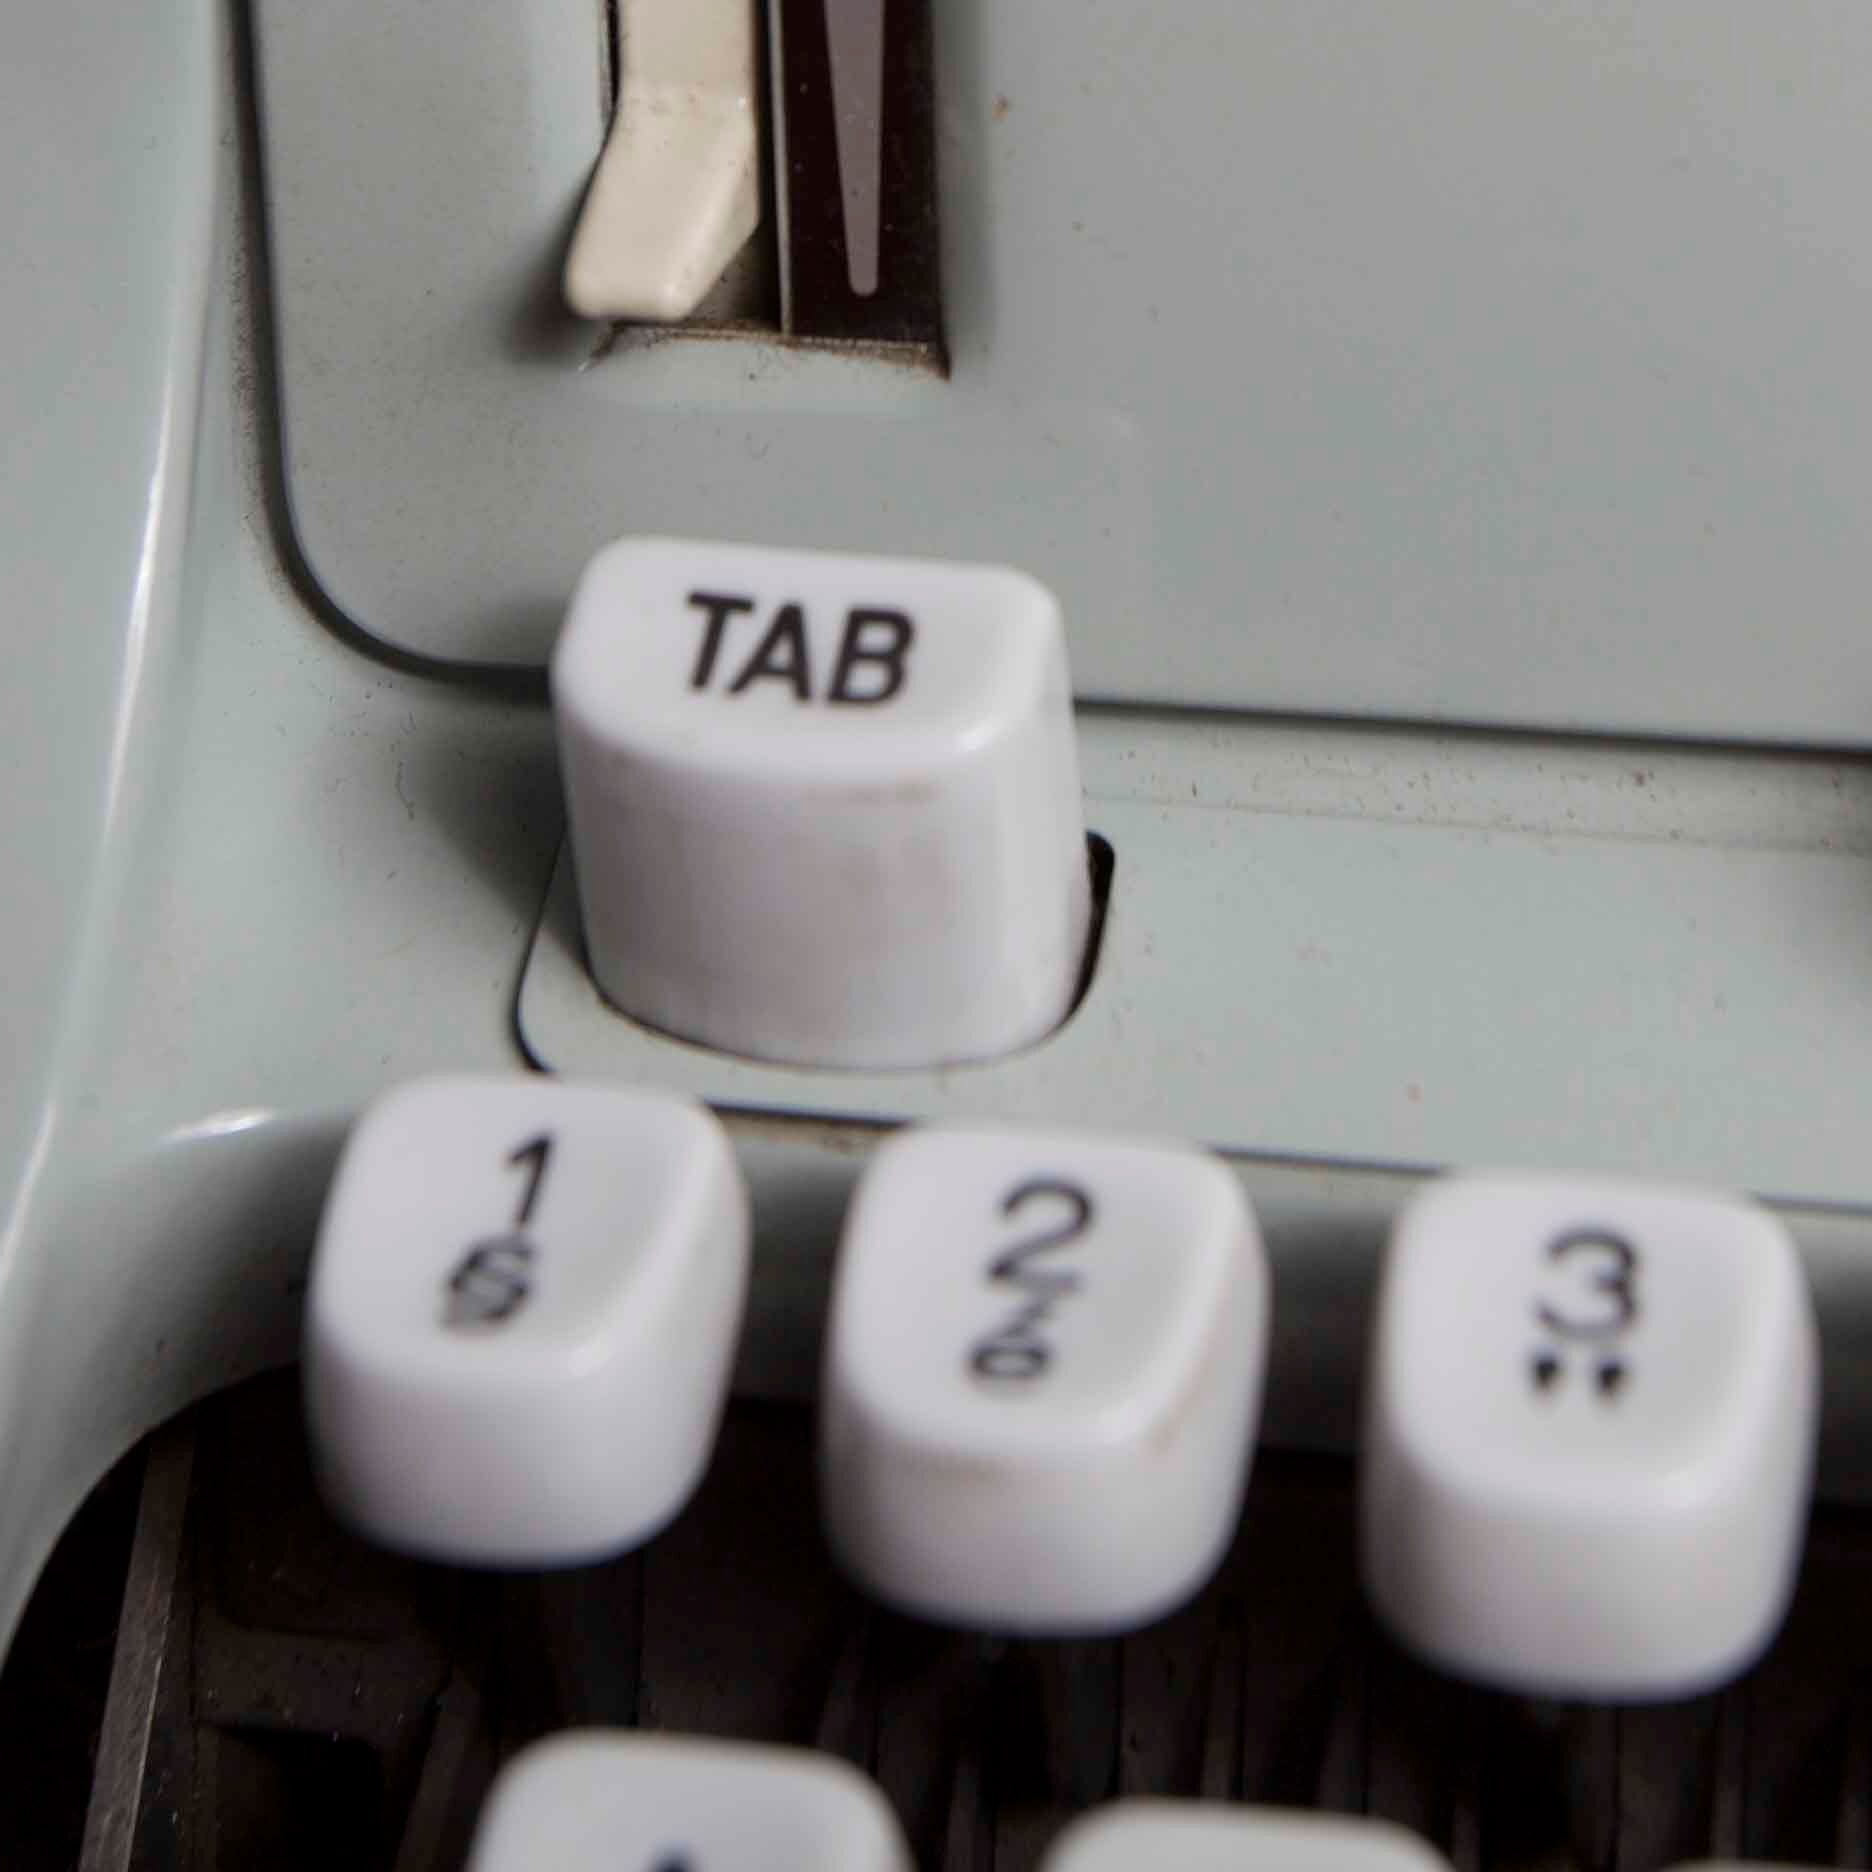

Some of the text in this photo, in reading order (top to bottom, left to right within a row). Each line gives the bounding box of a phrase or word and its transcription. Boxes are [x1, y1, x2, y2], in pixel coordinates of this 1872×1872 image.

[685, 591, 917, 707] TAB
[506, 1130, 554, 1228] 1
[990, 1176, 1094, 1294] 2
[1535, 1224, 1638, 1342] 3
